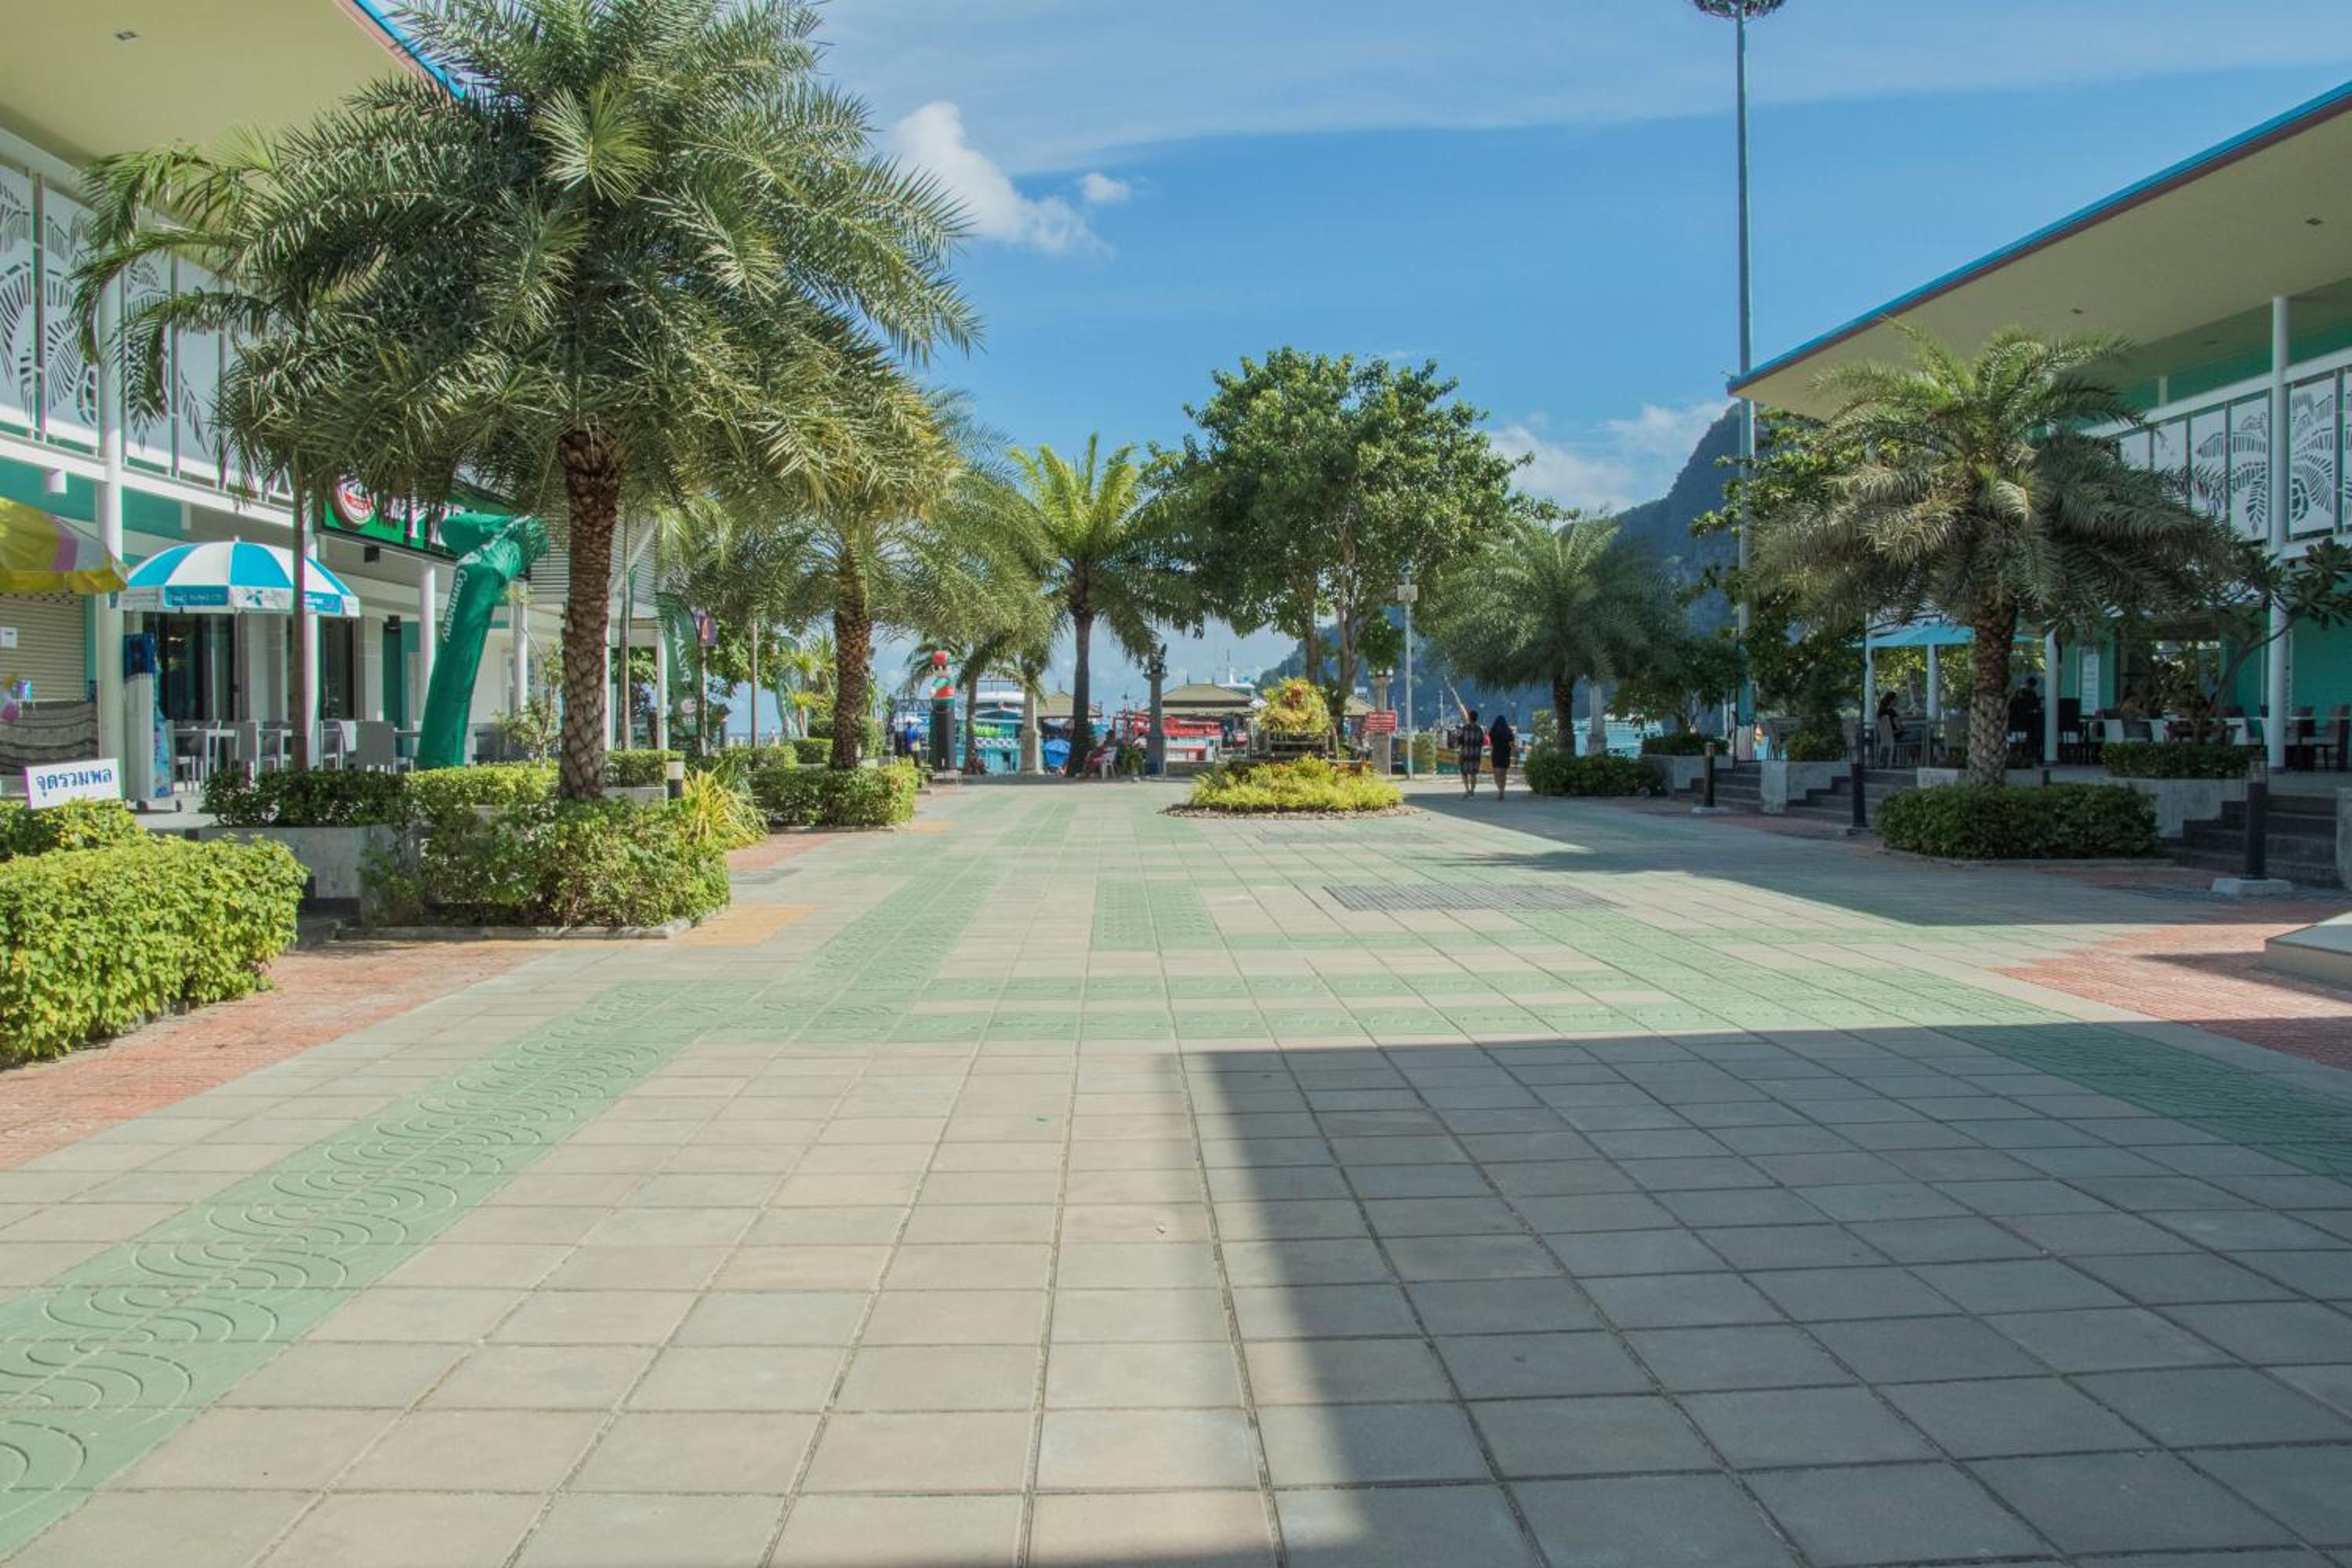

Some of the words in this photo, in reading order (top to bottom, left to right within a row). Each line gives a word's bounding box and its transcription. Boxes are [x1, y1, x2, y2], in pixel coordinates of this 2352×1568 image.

[442, 569, 468, 642] Company
[37, 768, 112, 797] จุดรวมพล
